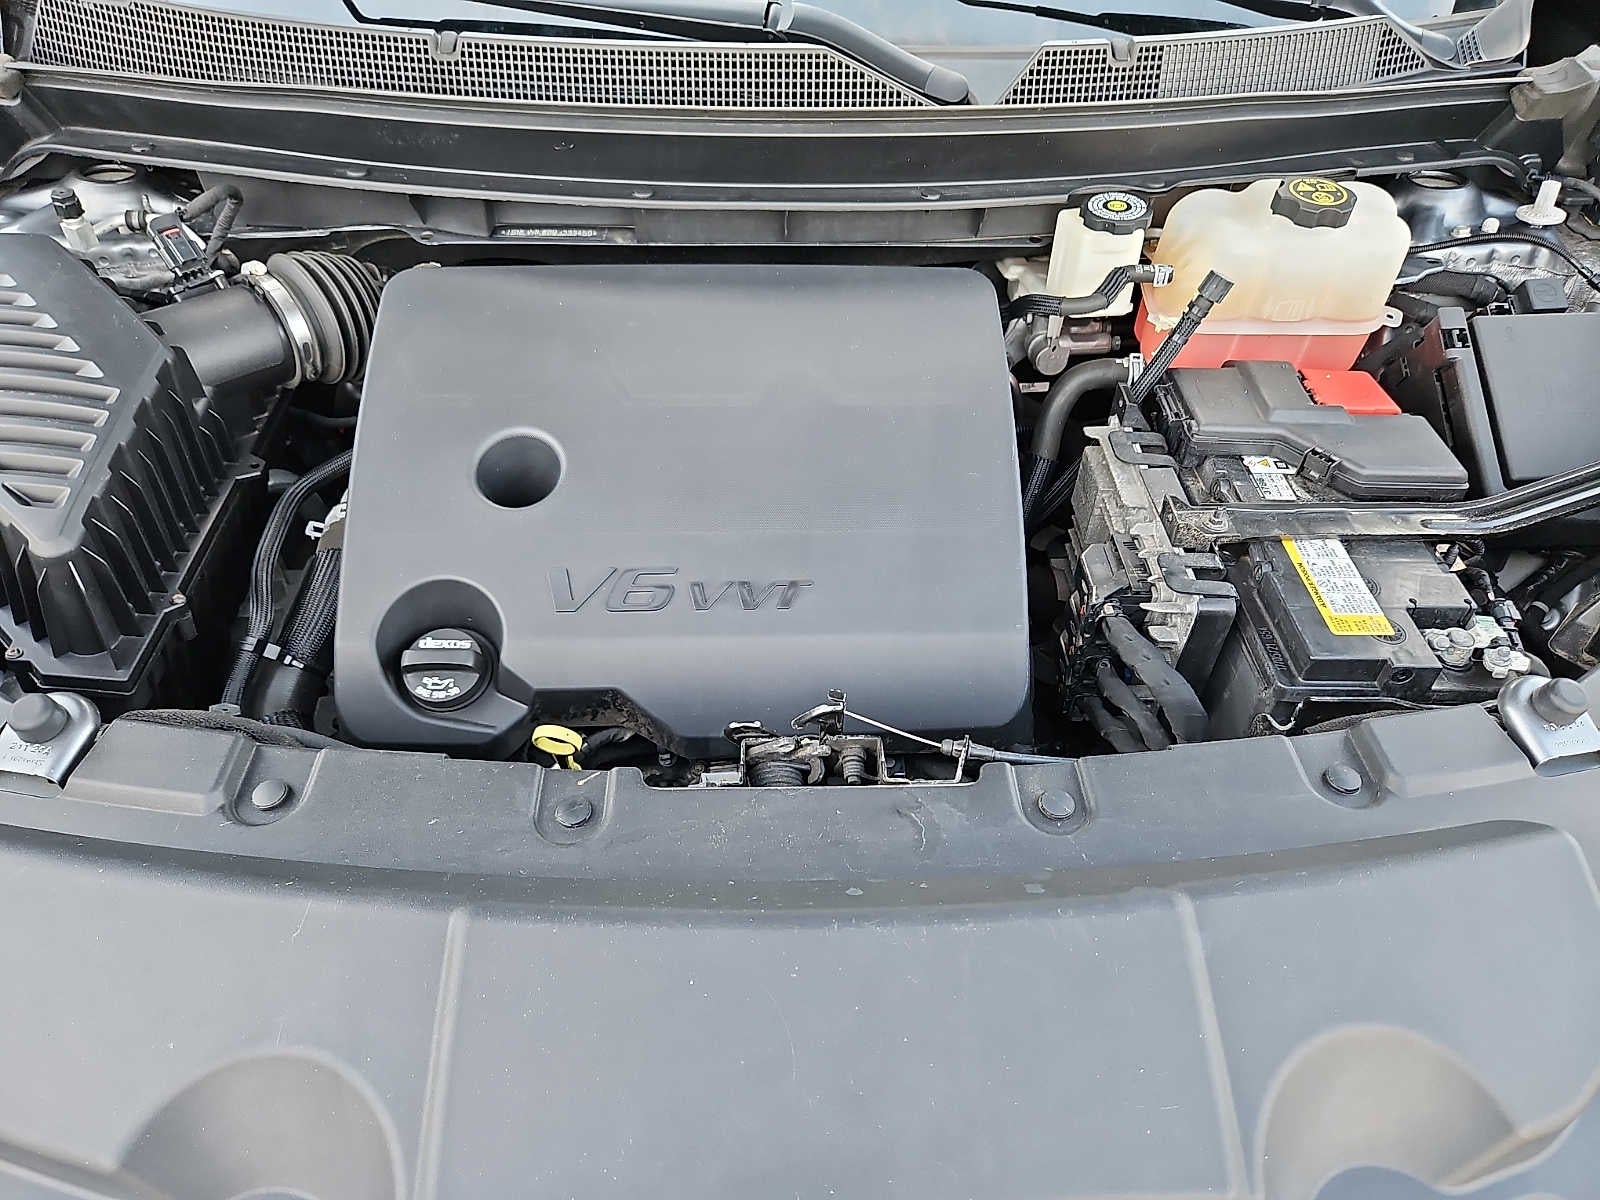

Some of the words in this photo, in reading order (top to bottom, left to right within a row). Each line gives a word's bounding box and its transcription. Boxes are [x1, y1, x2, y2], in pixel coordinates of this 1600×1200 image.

[547, 566, 679, 613] V6
[688, 579, 815, 612] VVT
[418, 636, 472, 649] dexos
